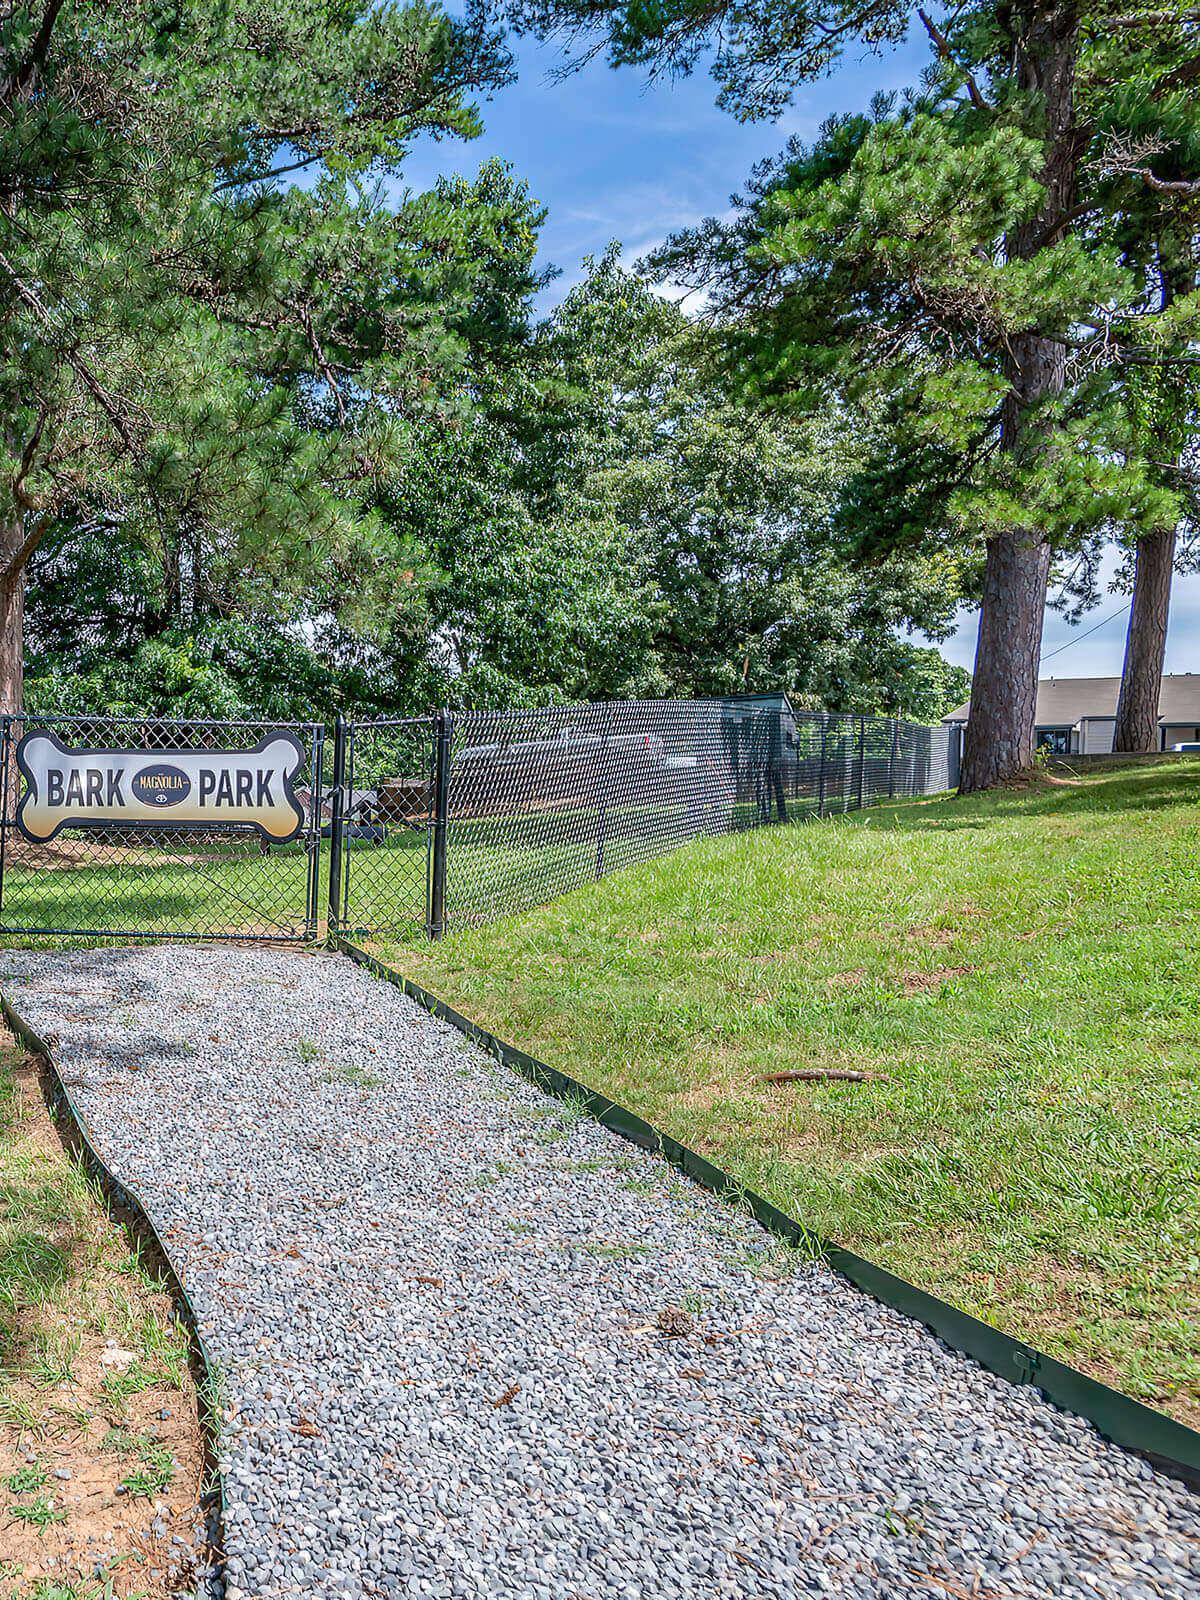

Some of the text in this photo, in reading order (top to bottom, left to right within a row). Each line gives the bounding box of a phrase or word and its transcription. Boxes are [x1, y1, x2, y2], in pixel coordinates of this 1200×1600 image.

[47, 769, 275, 806] BARK PARK
[141, 775, 184, 788] MAGNOLIA
